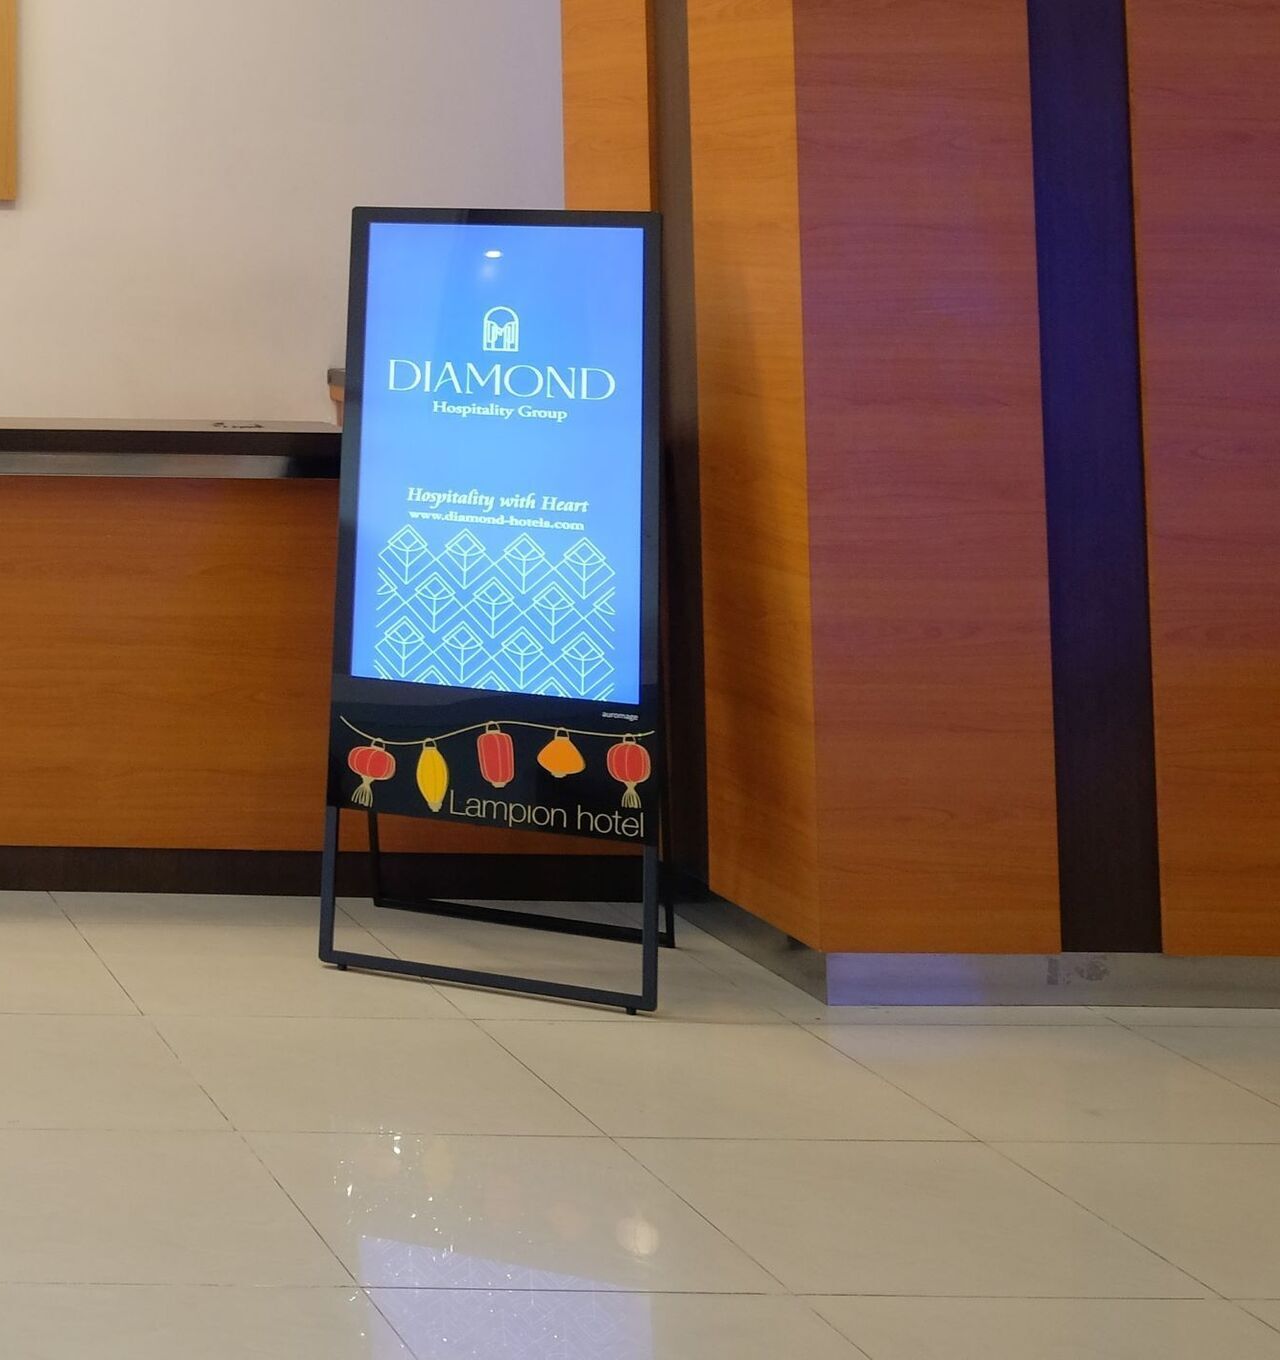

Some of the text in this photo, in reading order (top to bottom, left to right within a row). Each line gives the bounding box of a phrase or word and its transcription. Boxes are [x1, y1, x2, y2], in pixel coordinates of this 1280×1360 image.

[388, 359, 616, 401] DIAMOND
[432, 400, 568, 423] Hospitality Group
[406, 487, 589, 513] Hospitality with Heart
[409, 509, 585, 531] www.diamond-hotels.com
[450, 789, 645, 838] Lampion hotel
